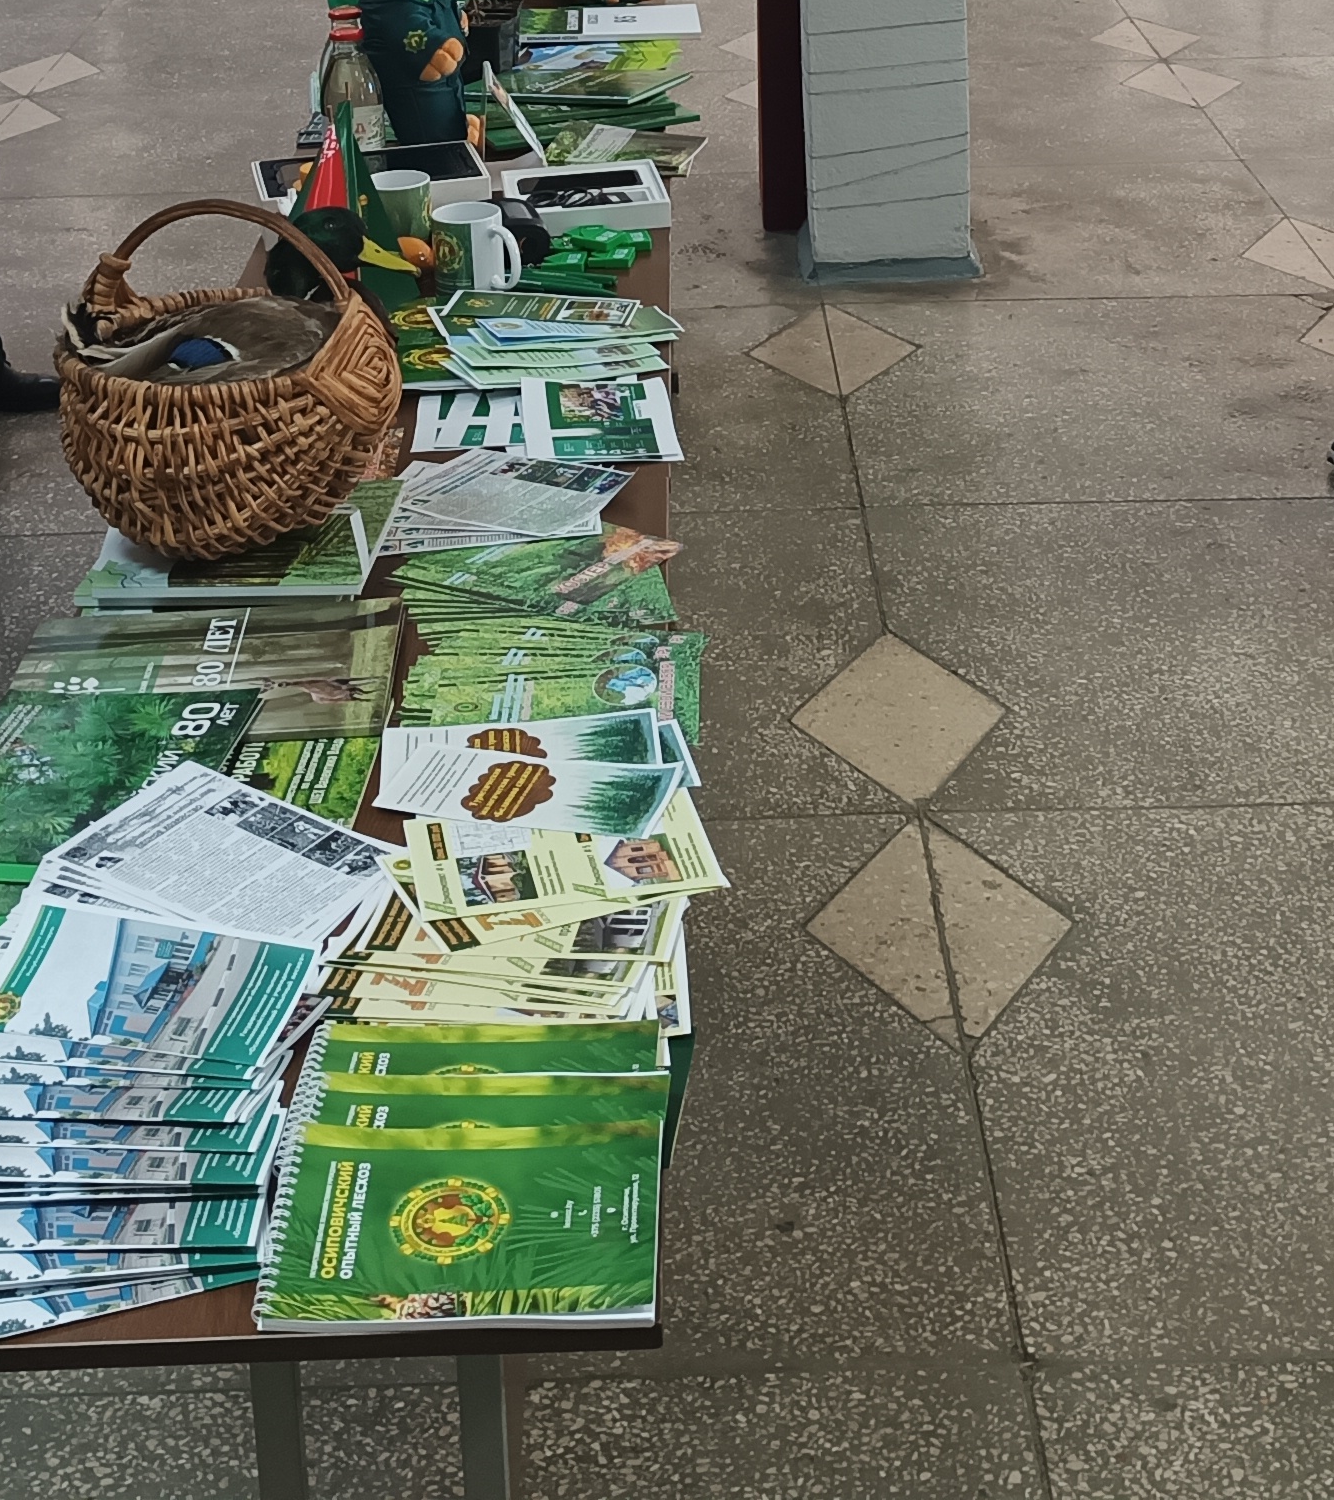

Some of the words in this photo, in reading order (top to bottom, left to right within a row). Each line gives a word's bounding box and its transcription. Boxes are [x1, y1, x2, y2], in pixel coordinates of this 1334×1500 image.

[202, 617, 238, 654] ЛЕТ
[192, 660, 225, 687] 80
[171, 702, 220, 736] 80
[216, 702, 240, 726] лет
[320, 1161, 355, 1279] ОСИПОВИЧСКИЙ
[339, 1211, 363, 1280] ОПЫТНЫЙ
[351, 1162, 371, 1210] ЛЕСХОЗ
